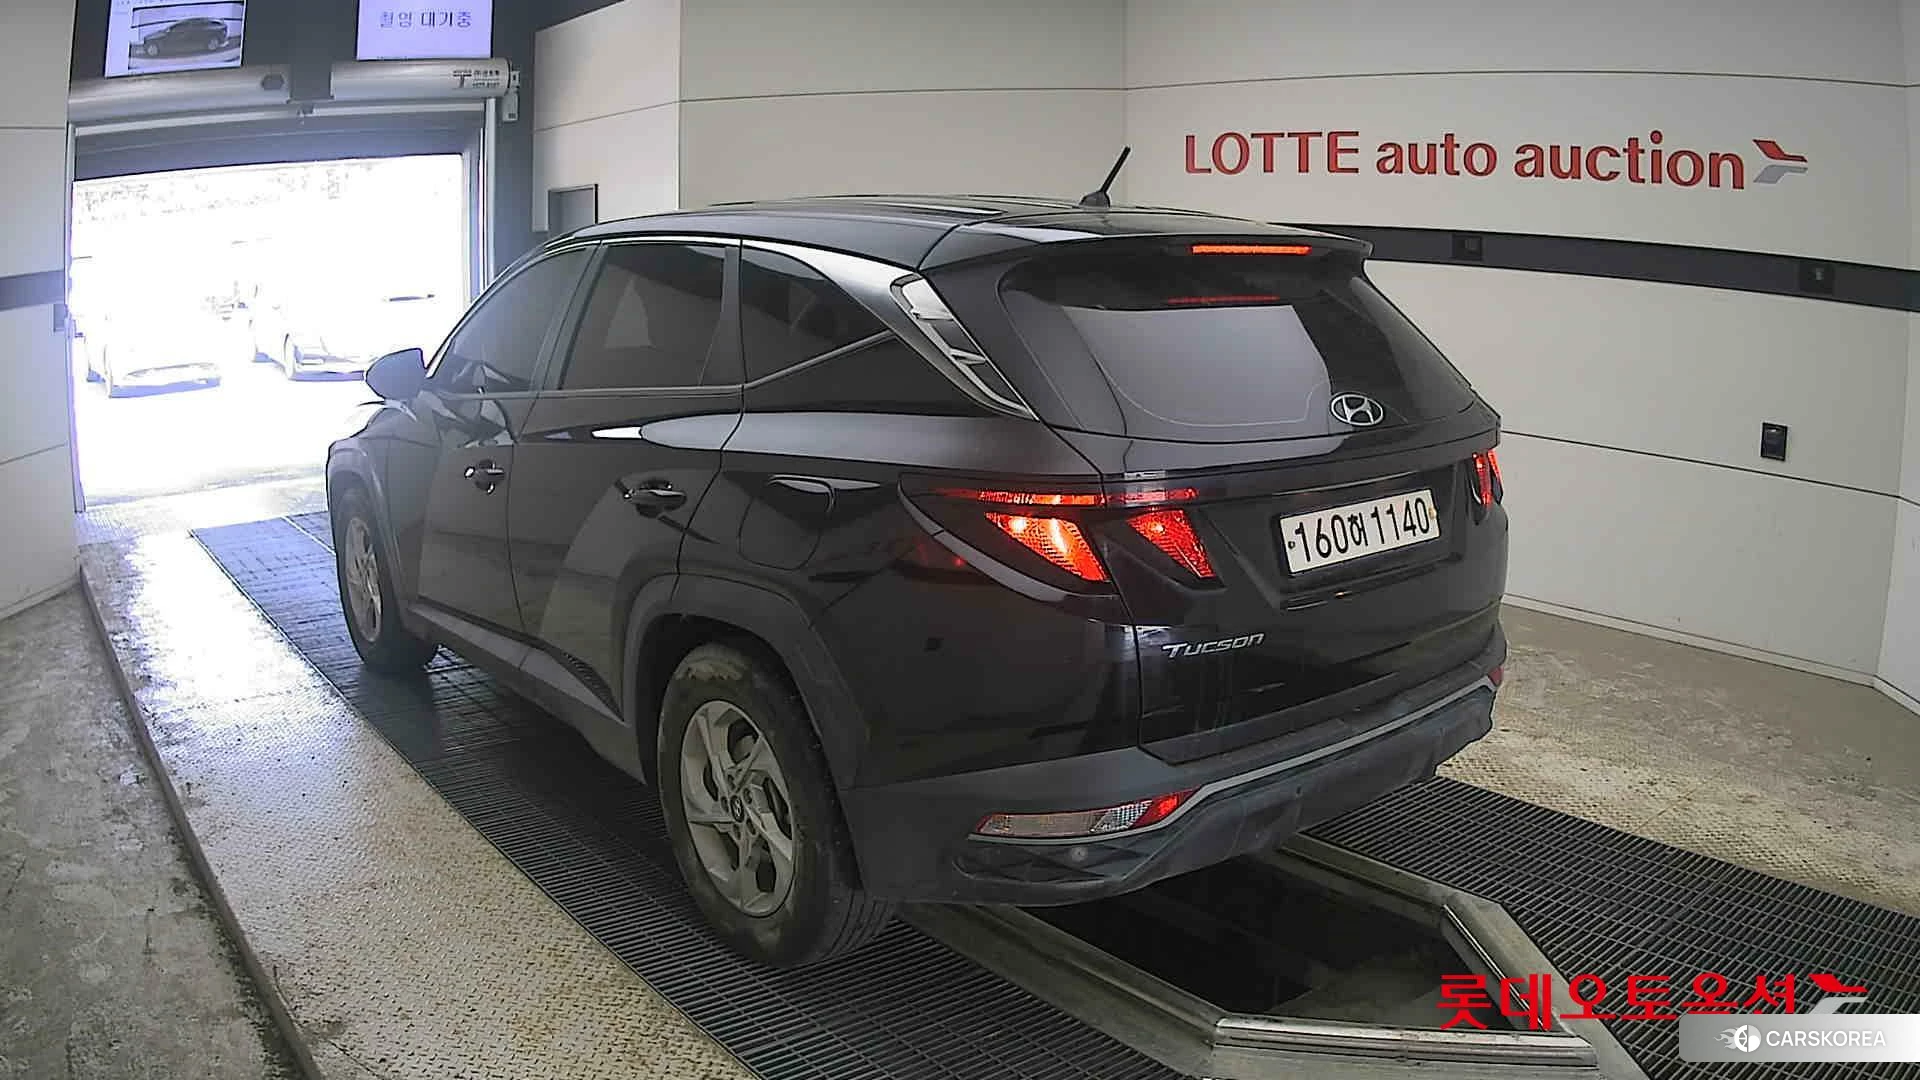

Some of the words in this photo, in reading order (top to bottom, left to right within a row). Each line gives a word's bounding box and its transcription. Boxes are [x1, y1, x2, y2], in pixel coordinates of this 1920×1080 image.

[420, 11, 472, 28] 대기중
[1185, 131, 1360, 175] LOTTE
[1376, 132, 1498, 177] auto
[1513, 131, 1746, 190] auction
